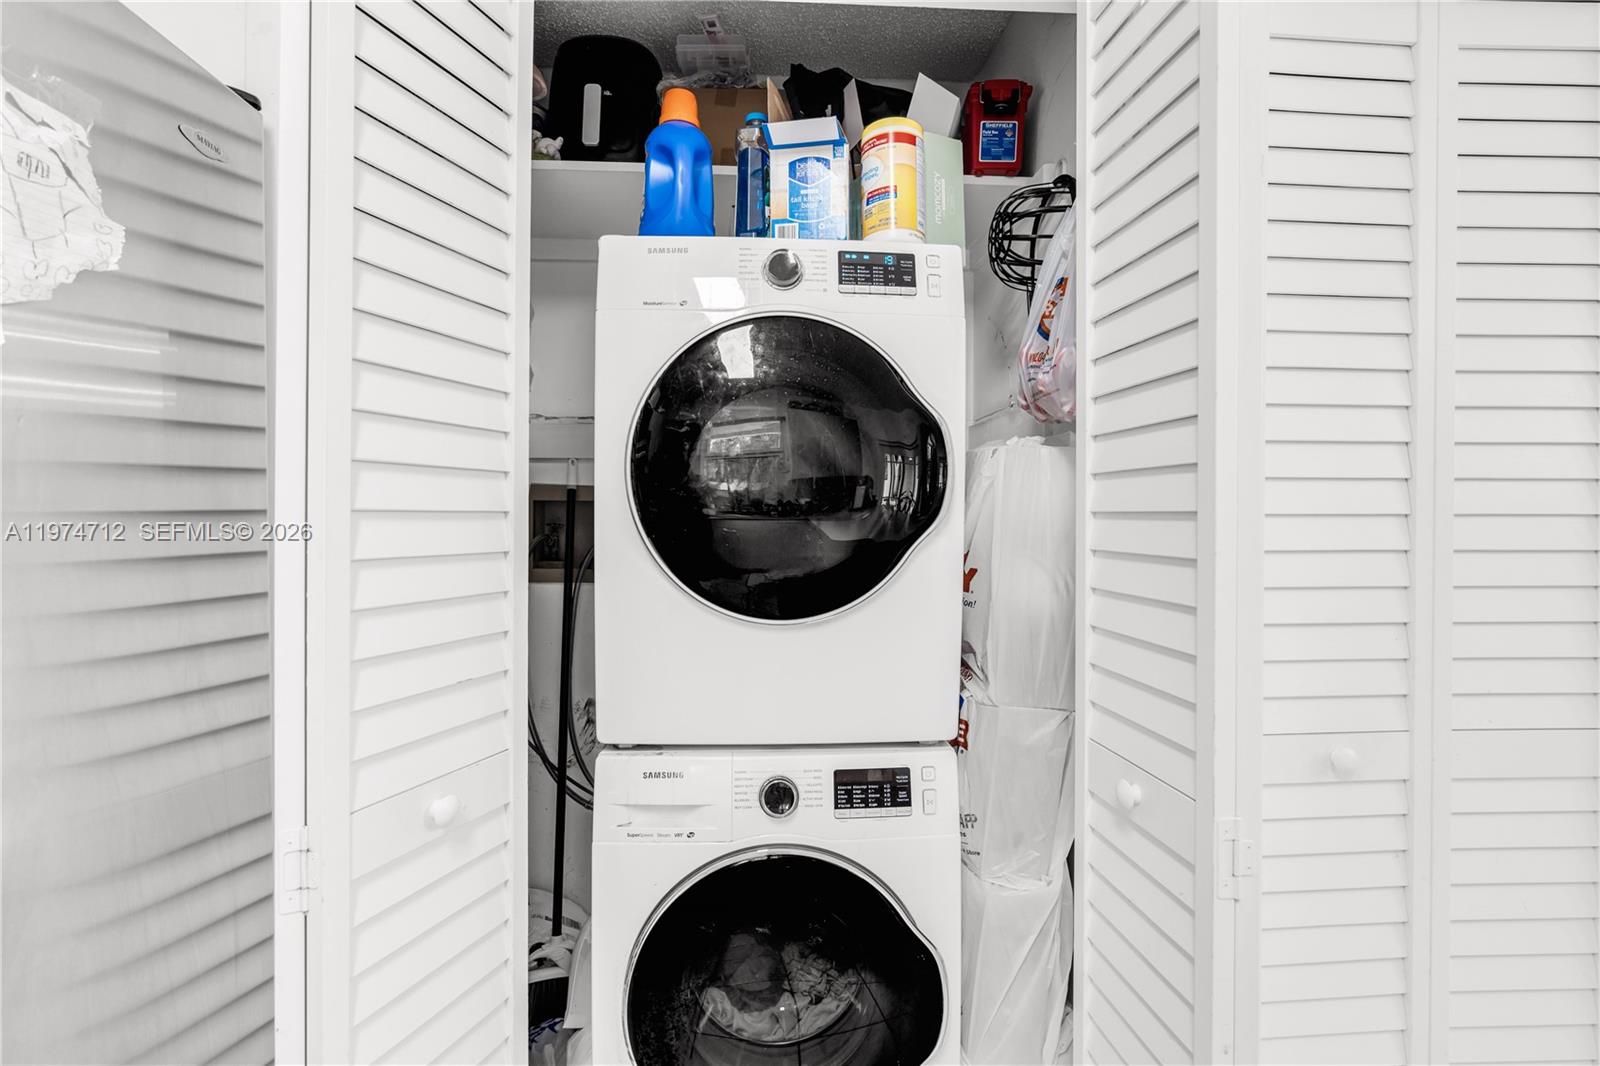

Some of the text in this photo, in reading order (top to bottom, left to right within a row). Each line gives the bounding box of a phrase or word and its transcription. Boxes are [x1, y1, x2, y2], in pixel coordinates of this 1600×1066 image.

[934, 171, 942, 225] momcozy
[647, 247, 689, 255] SAMSUNG
[642, 771, 685, 780] SAMSUNG
